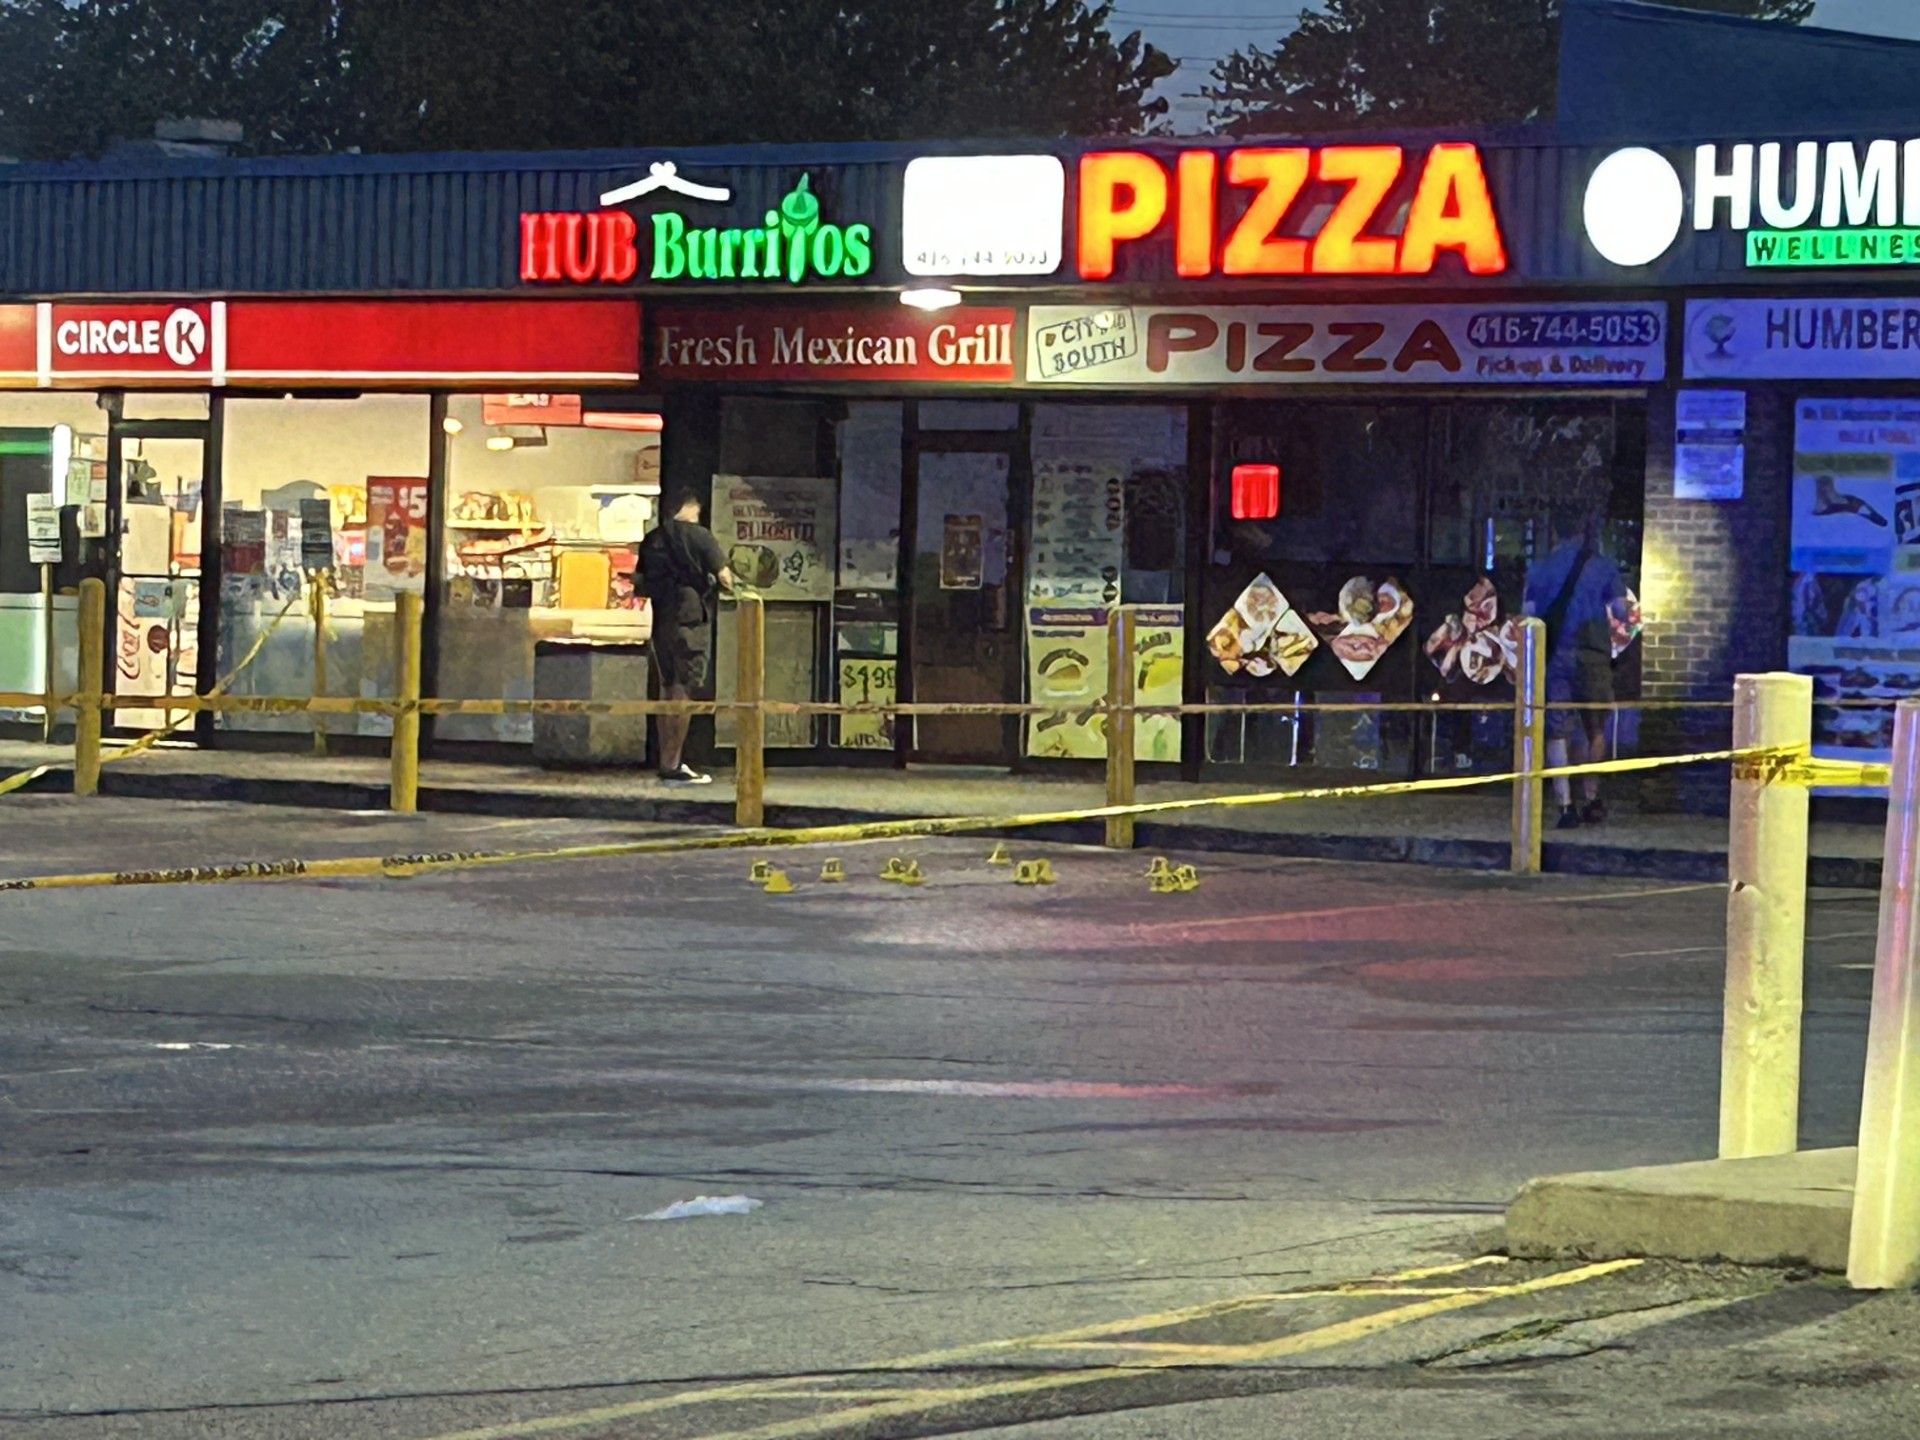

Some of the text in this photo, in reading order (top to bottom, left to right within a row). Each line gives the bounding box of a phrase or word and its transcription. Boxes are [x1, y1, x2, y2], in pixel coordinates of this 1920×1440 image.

[519, 178, 871, 284] HUB Burritos
[1078, 142, 1506, 280] PIZZA
[57, 315, 200, 361] CIRCLE K
[659, 323, 1013, 366] Fresh Mexican Grill
[1146, 313, 1461, 373] PIZZA
[1469, 315, 1656, 343] 416-744-5053
[1766, 307, 1920, 350] HUMBER
[1053, 336, 1125, 372] SOUTH
